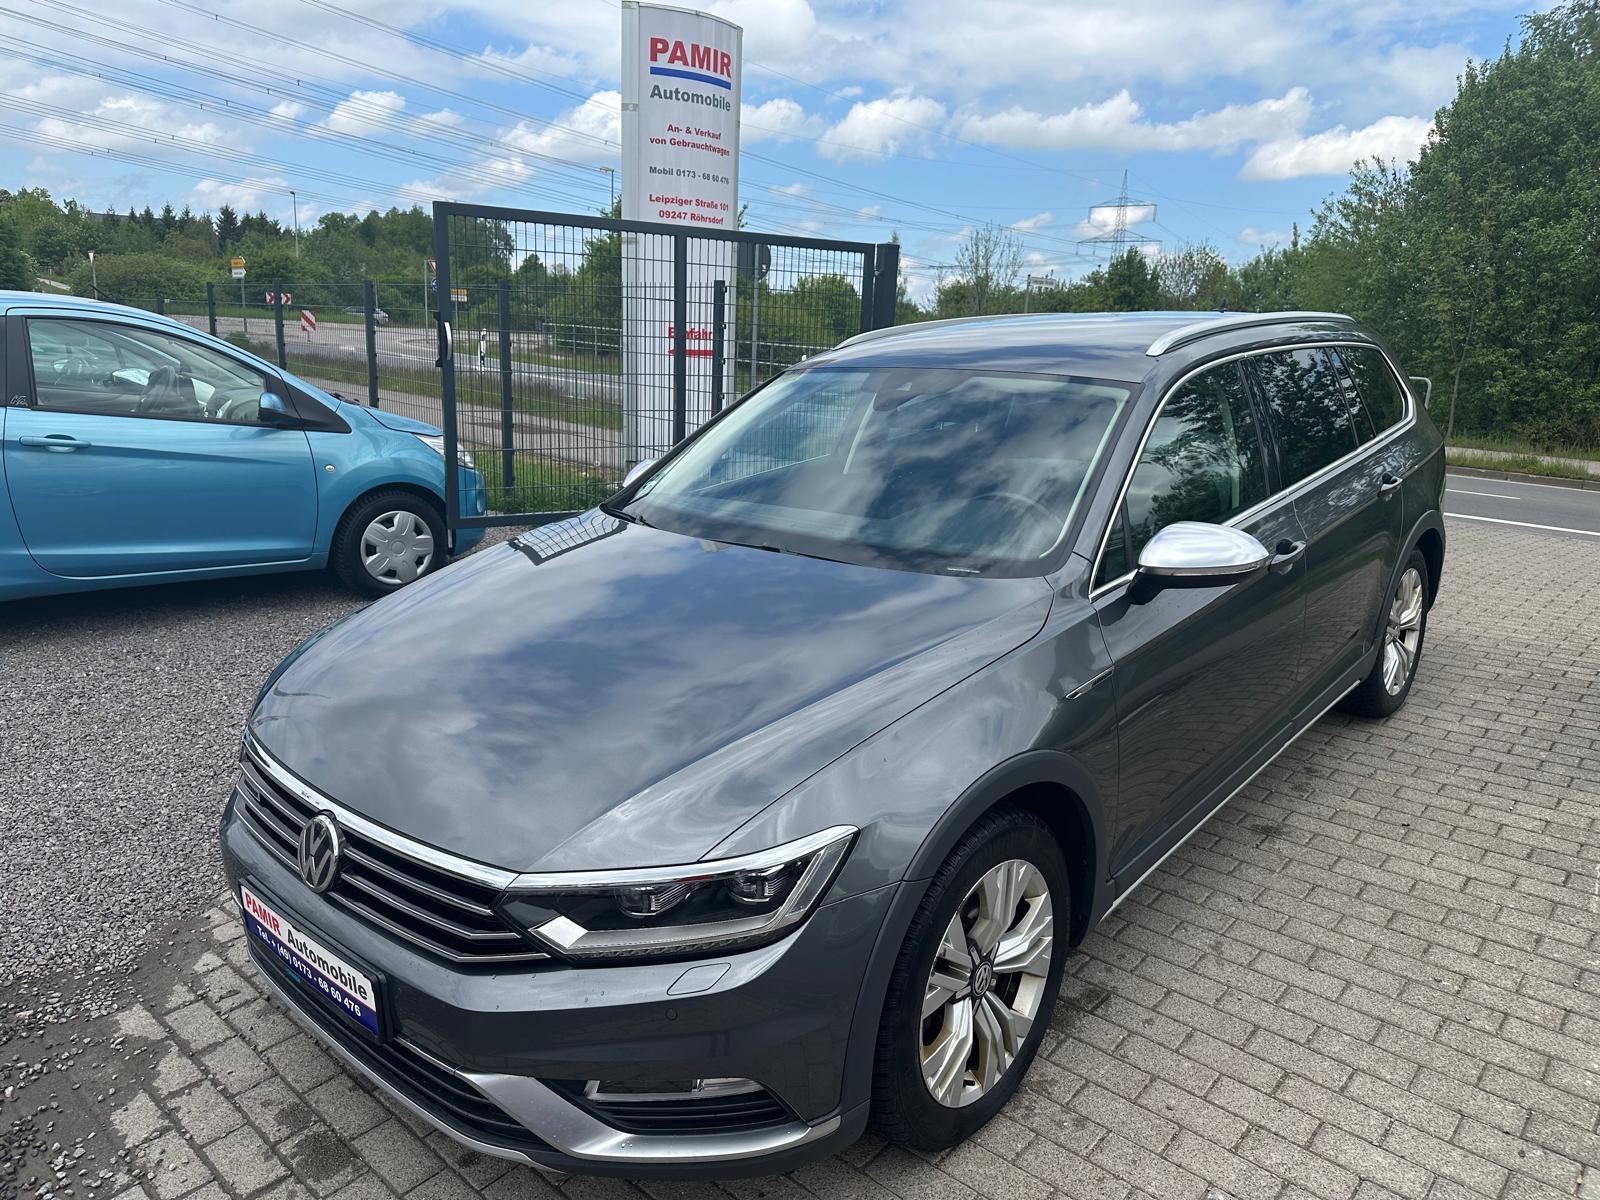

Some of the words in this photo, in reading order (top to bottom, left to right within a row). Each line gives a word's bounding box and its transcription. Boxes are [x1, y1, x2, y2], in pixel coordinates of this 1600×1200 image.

[649, 37, 731, 78] PAMIR
[650, 85, 731, 111] Automobile
[667, 124, 682, 132] An-
[685, 127, 692, 135] &
[695, 128, 721, 140] Verkauf
[649, 137, 666, 145] von
[670, 138, 730, 156] Gebrauchtwagen
[649, 166, 674, 176] Mobil
[676, 169, 696, 179] 0173
[702, 173, 711, 181] 68
[649, 194, 692, 206] Leipziger
[695, 199, 718, 209] Straße
[720, 202, 729, 212] 101
[659, 210, 687, 220] 09247
[690, 213, 724, 225] Röhrsdorf
[245, 892, 281, 936] PAMIR
[257, 925, 270, 944] Tel.
[293, 956, 312, 979] 0173
[318, 977, 329, 993] 68
[330, 987, 342, 1002] 60
[344, 997, 361, 1017] 476
[288, 929, 368, 1000] Automobile
